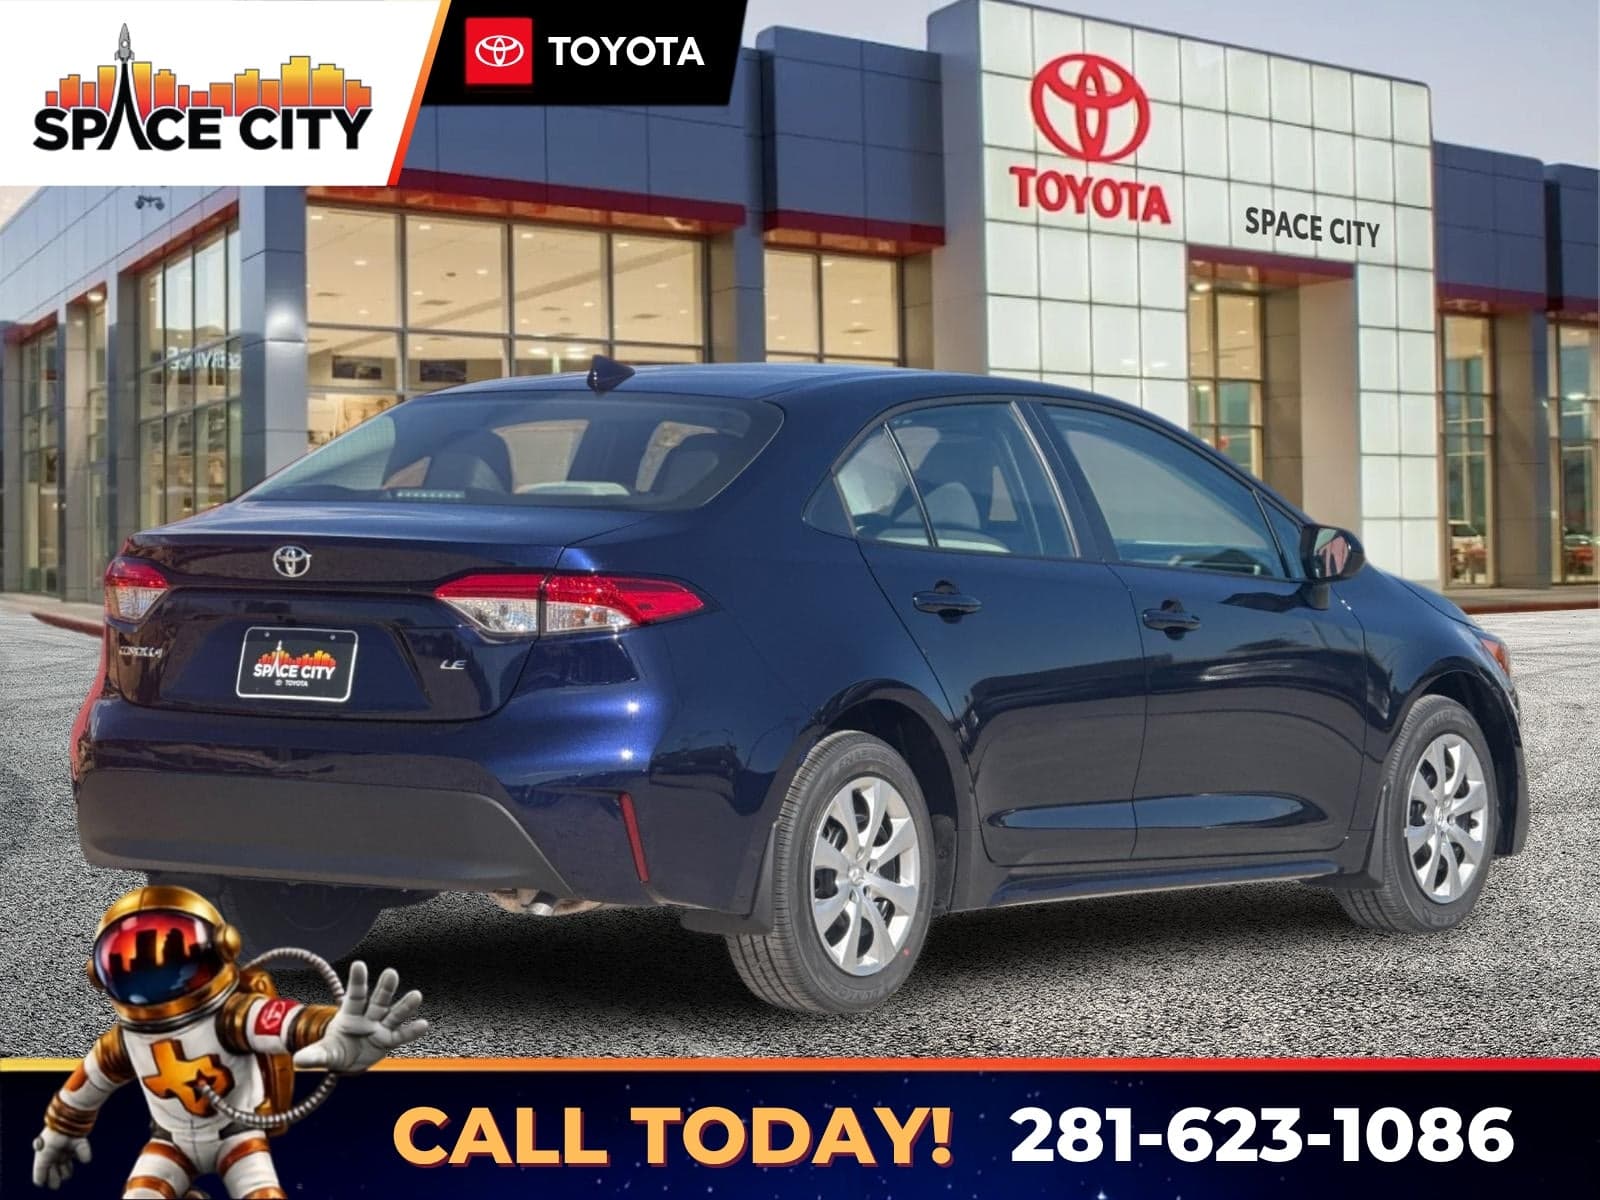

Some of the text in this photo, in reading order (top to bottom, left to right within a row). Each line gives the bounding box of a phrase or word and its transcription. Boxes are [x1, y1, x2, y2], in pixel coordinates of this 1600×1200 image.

[1009, 166, 1171, 225] TOYOTA
[1245, 206, 1381, 248] SPACE CITY
[253, 663, 336, 680] SPACE CITY
[440, 659, 466, 670] LE
[285, 679, 309, 687] TOYOTA
